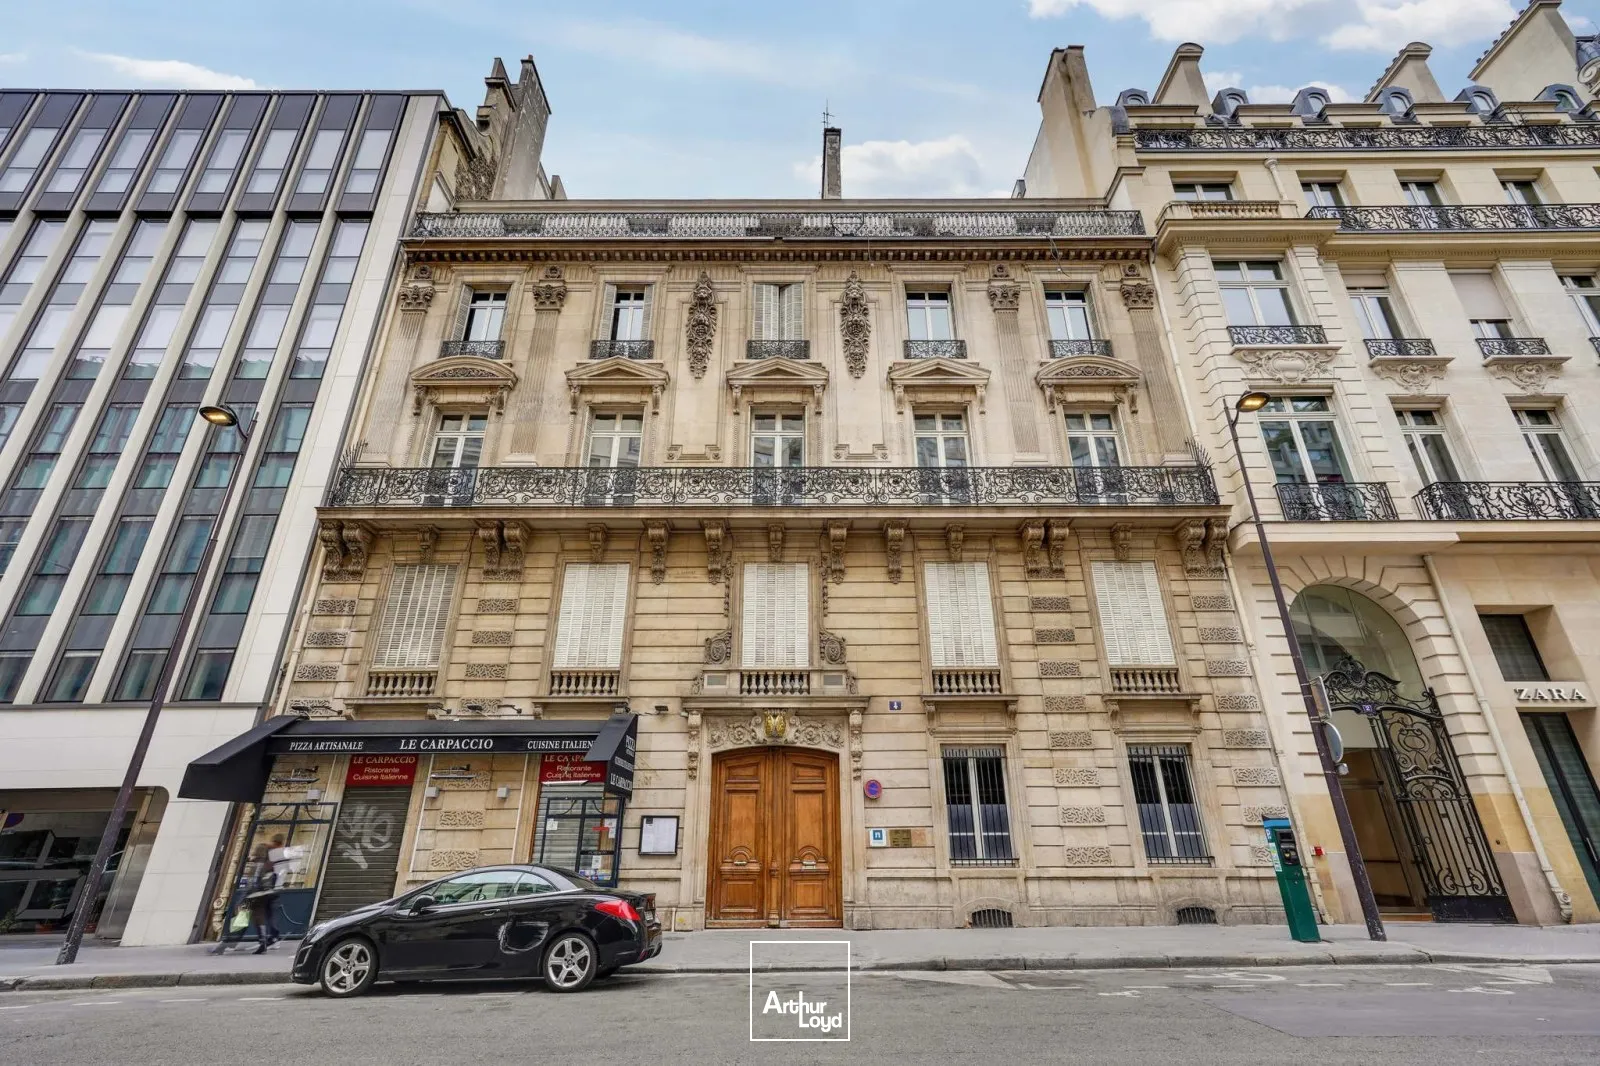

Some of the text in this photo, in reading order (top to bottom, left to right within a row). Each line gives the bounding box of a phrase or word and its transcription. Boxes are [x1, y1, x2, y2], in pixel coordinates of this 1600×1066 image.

[1514, 688, 1587, 702] ZARA
[289, 742, 364, 751] PIZZA ARTISANALE
[400, 739, 494, 750] LE CARPACCIO
[527, 740, 560, 749] CUISINE
[353, 756, 416, 764] LE CARPACCIO
[364, 766, 400, 774] Ristorante
[380, 772, 409, 780] Italienne
